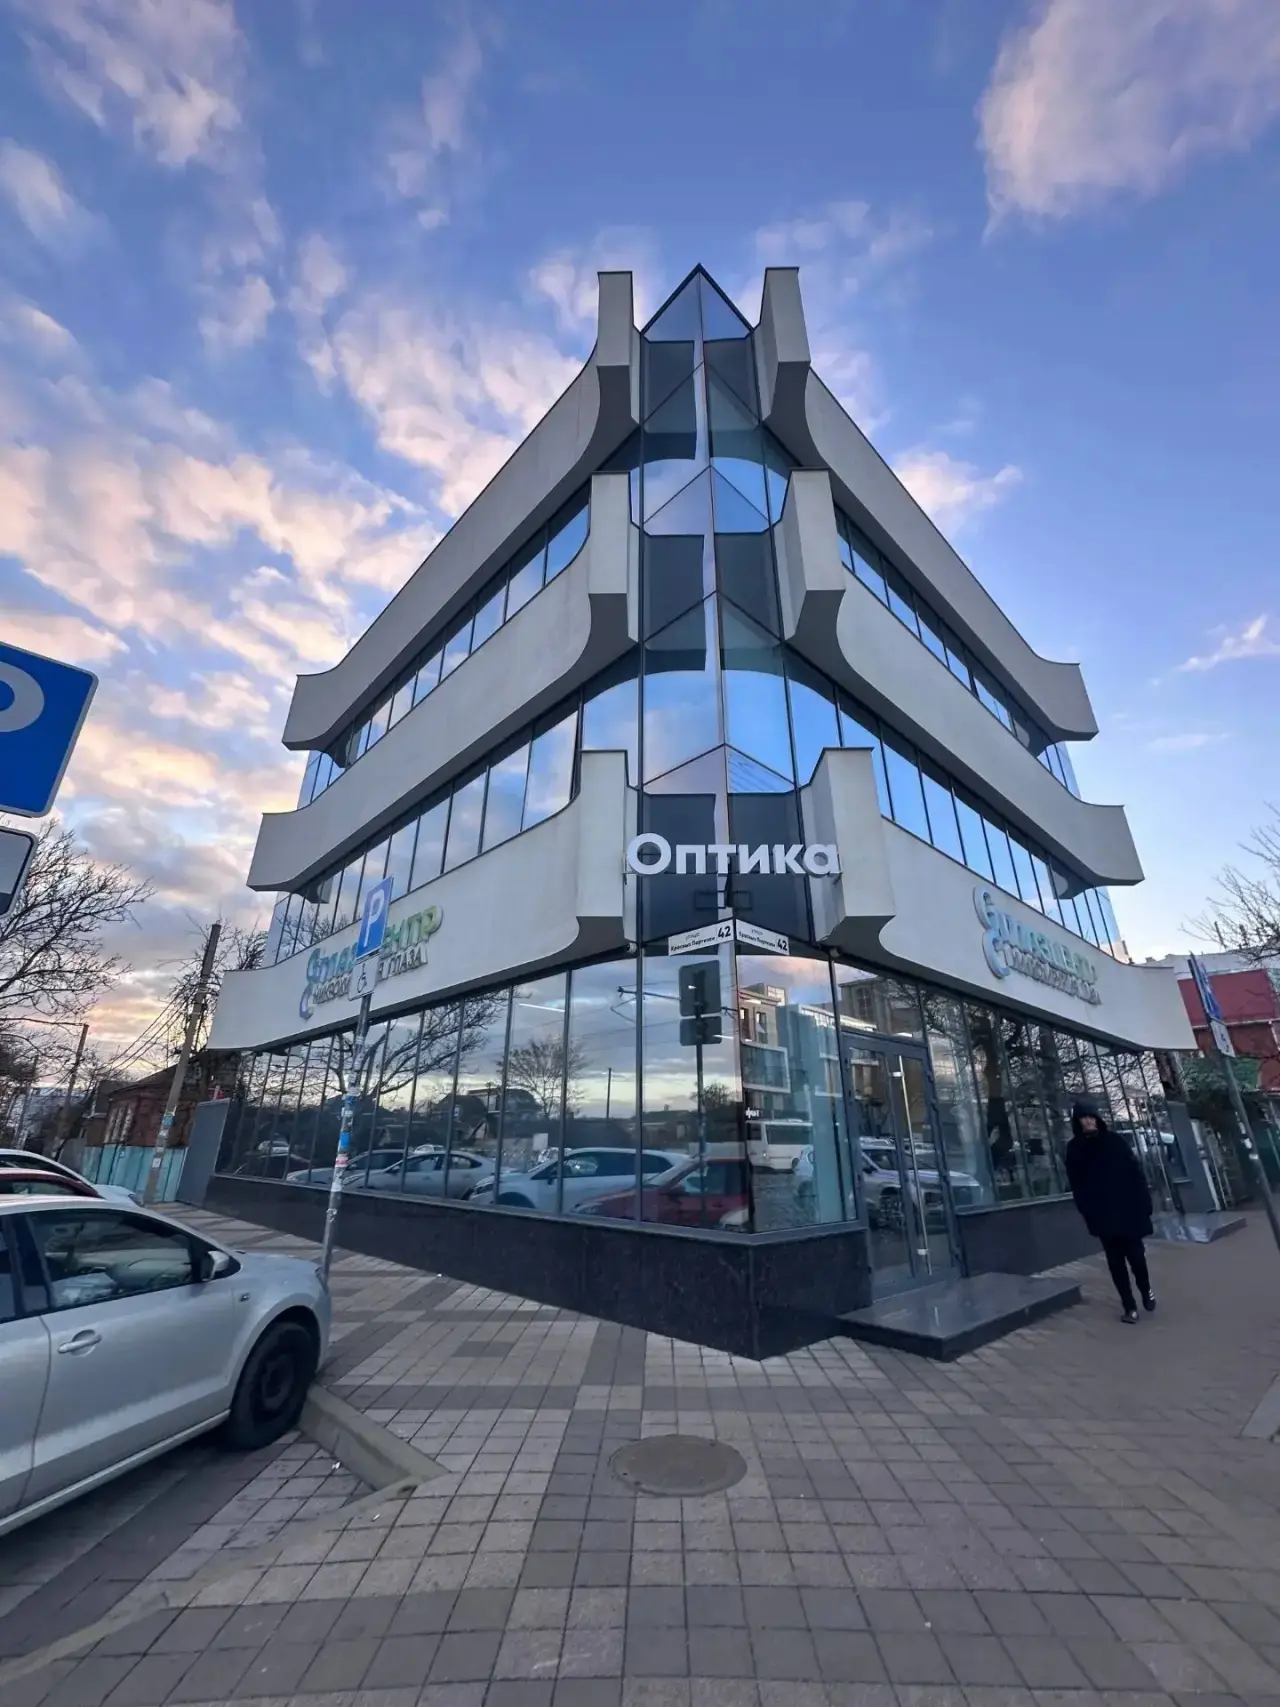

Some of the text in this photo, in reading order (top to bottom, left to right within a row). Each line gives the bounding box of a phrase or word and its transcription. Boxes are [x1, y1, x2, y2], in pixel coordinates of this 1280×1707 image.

[627, 833, 840, 877] Оптика
[718, 925, 731, 938] 42
[777, 939, 787, 951] 42
